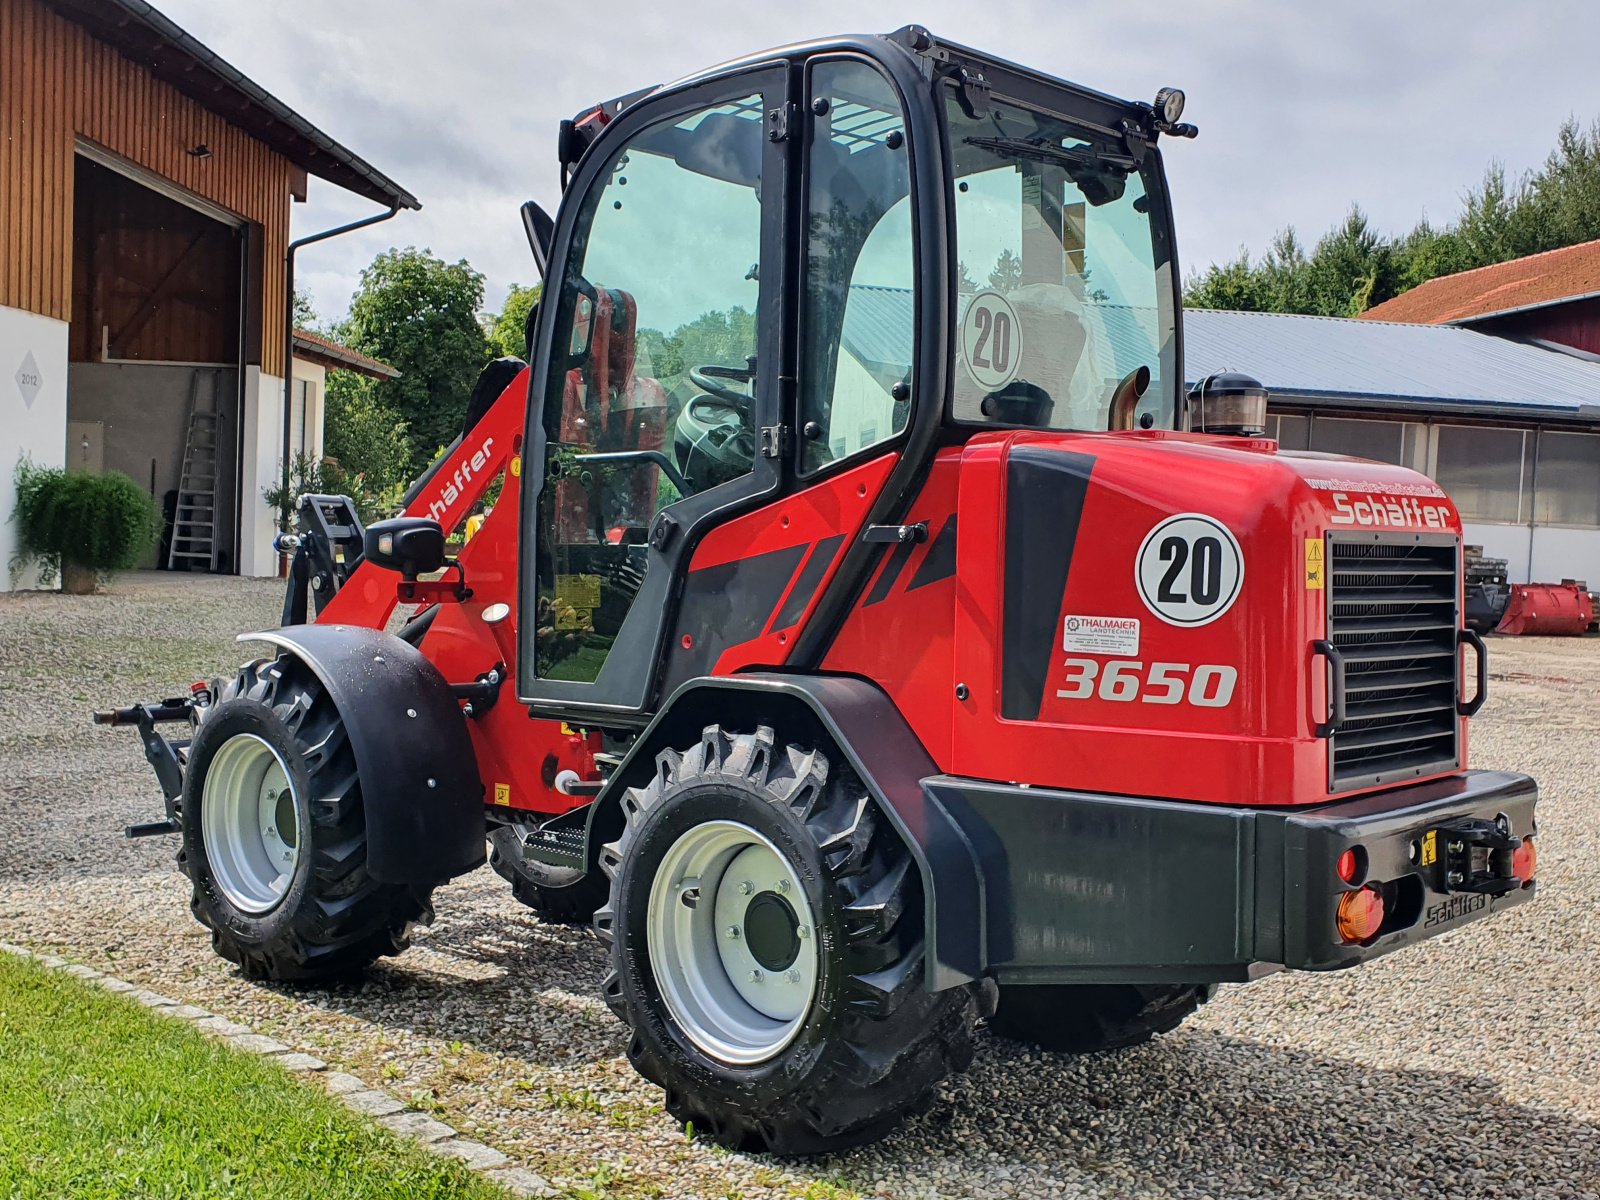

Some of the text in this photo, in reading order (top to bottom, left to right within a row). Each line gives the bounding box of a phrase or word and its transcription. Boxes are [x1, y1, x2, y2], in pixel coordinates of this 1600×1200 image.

[972, 306, 1011, 373] 20
[21, 373, 38, 386] 2012
[425, 437, 494, 521] häffer
[1331, 493, 1451, 528] Schäffer
[1157, 536, 1222, 605] 20
[1080, 618, 1136, 630] THALMAIER
[1089, 628, 1136, 636] LANDTECHNIK
[1056, 658, 1238, 708] 3650
[1424, 893, 1486, 929] Schäffer
